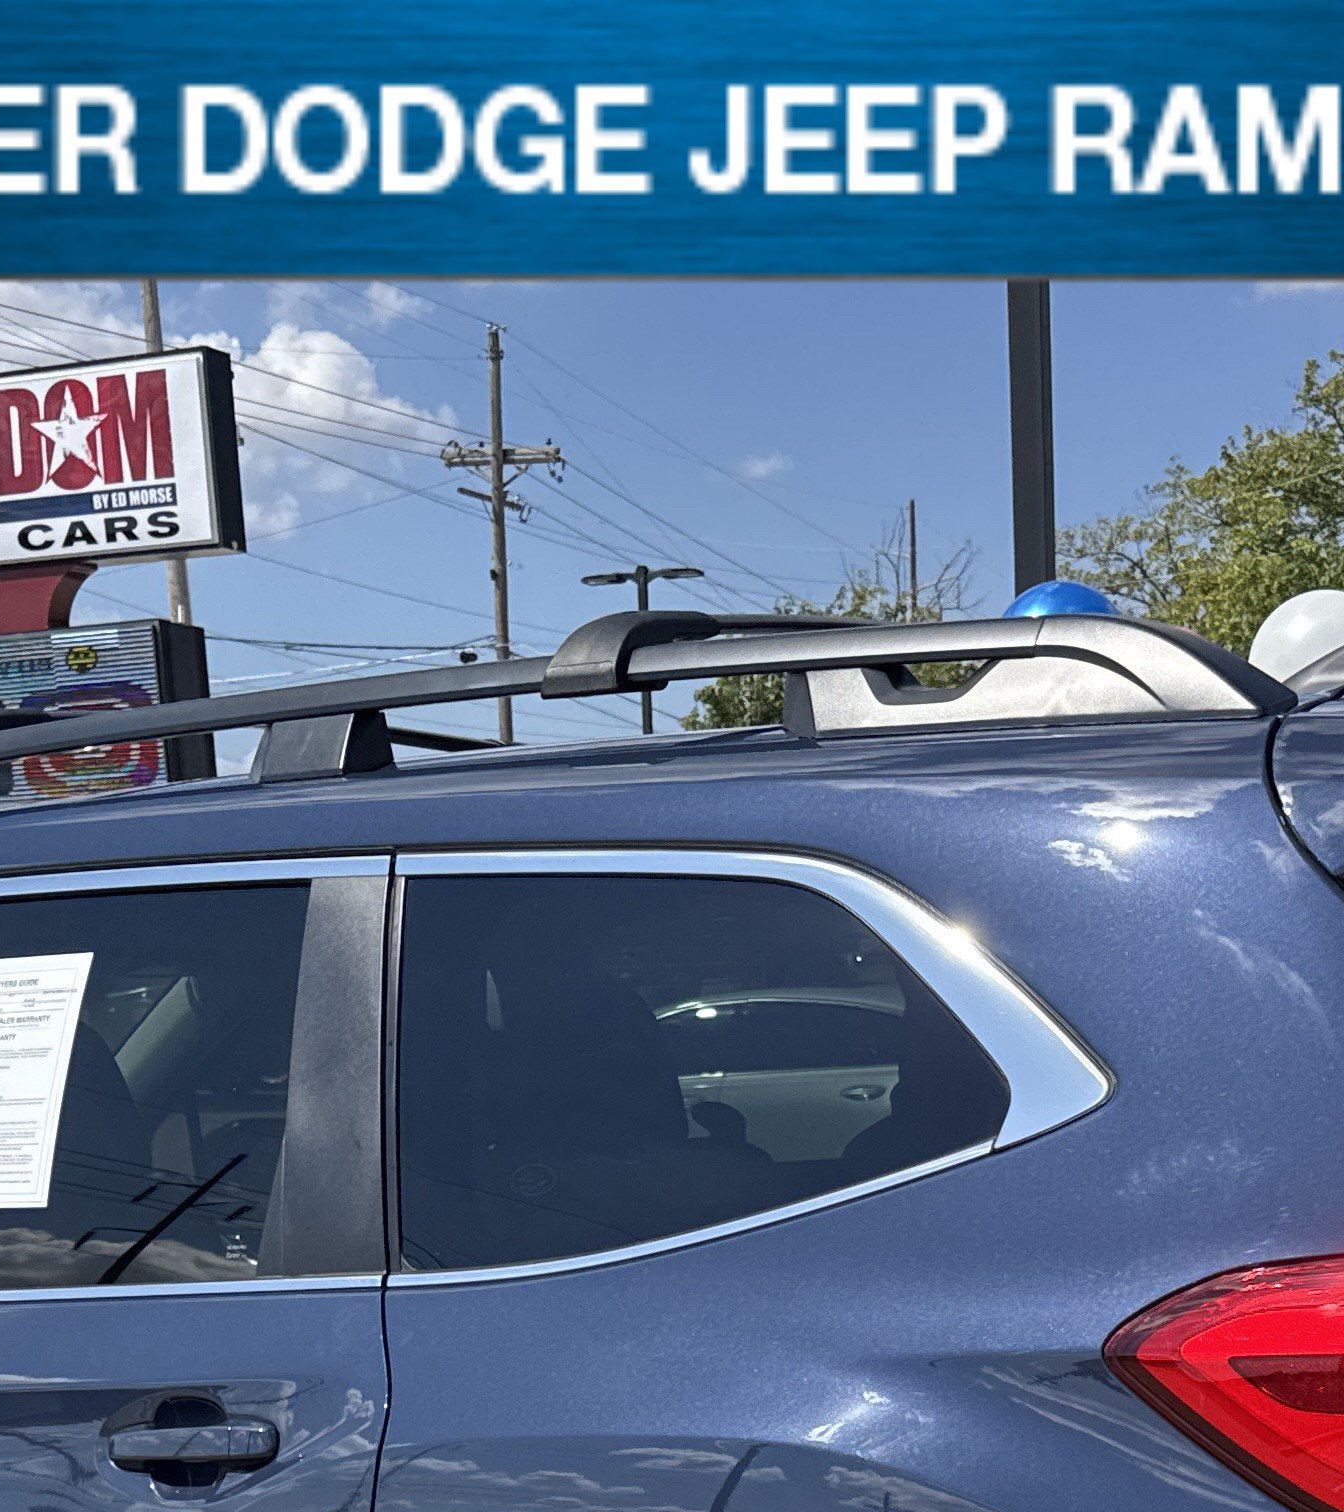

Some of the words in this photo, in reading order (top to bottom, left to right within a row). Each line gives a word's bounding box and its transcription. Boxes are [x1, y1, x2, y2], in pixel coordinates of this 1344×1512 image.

[92, 491, 111, 510] BY
[111, 489, 128, 508] ED
[129, 486, 173, 506] MORSE
[17, 510, 181, 551] CARS
